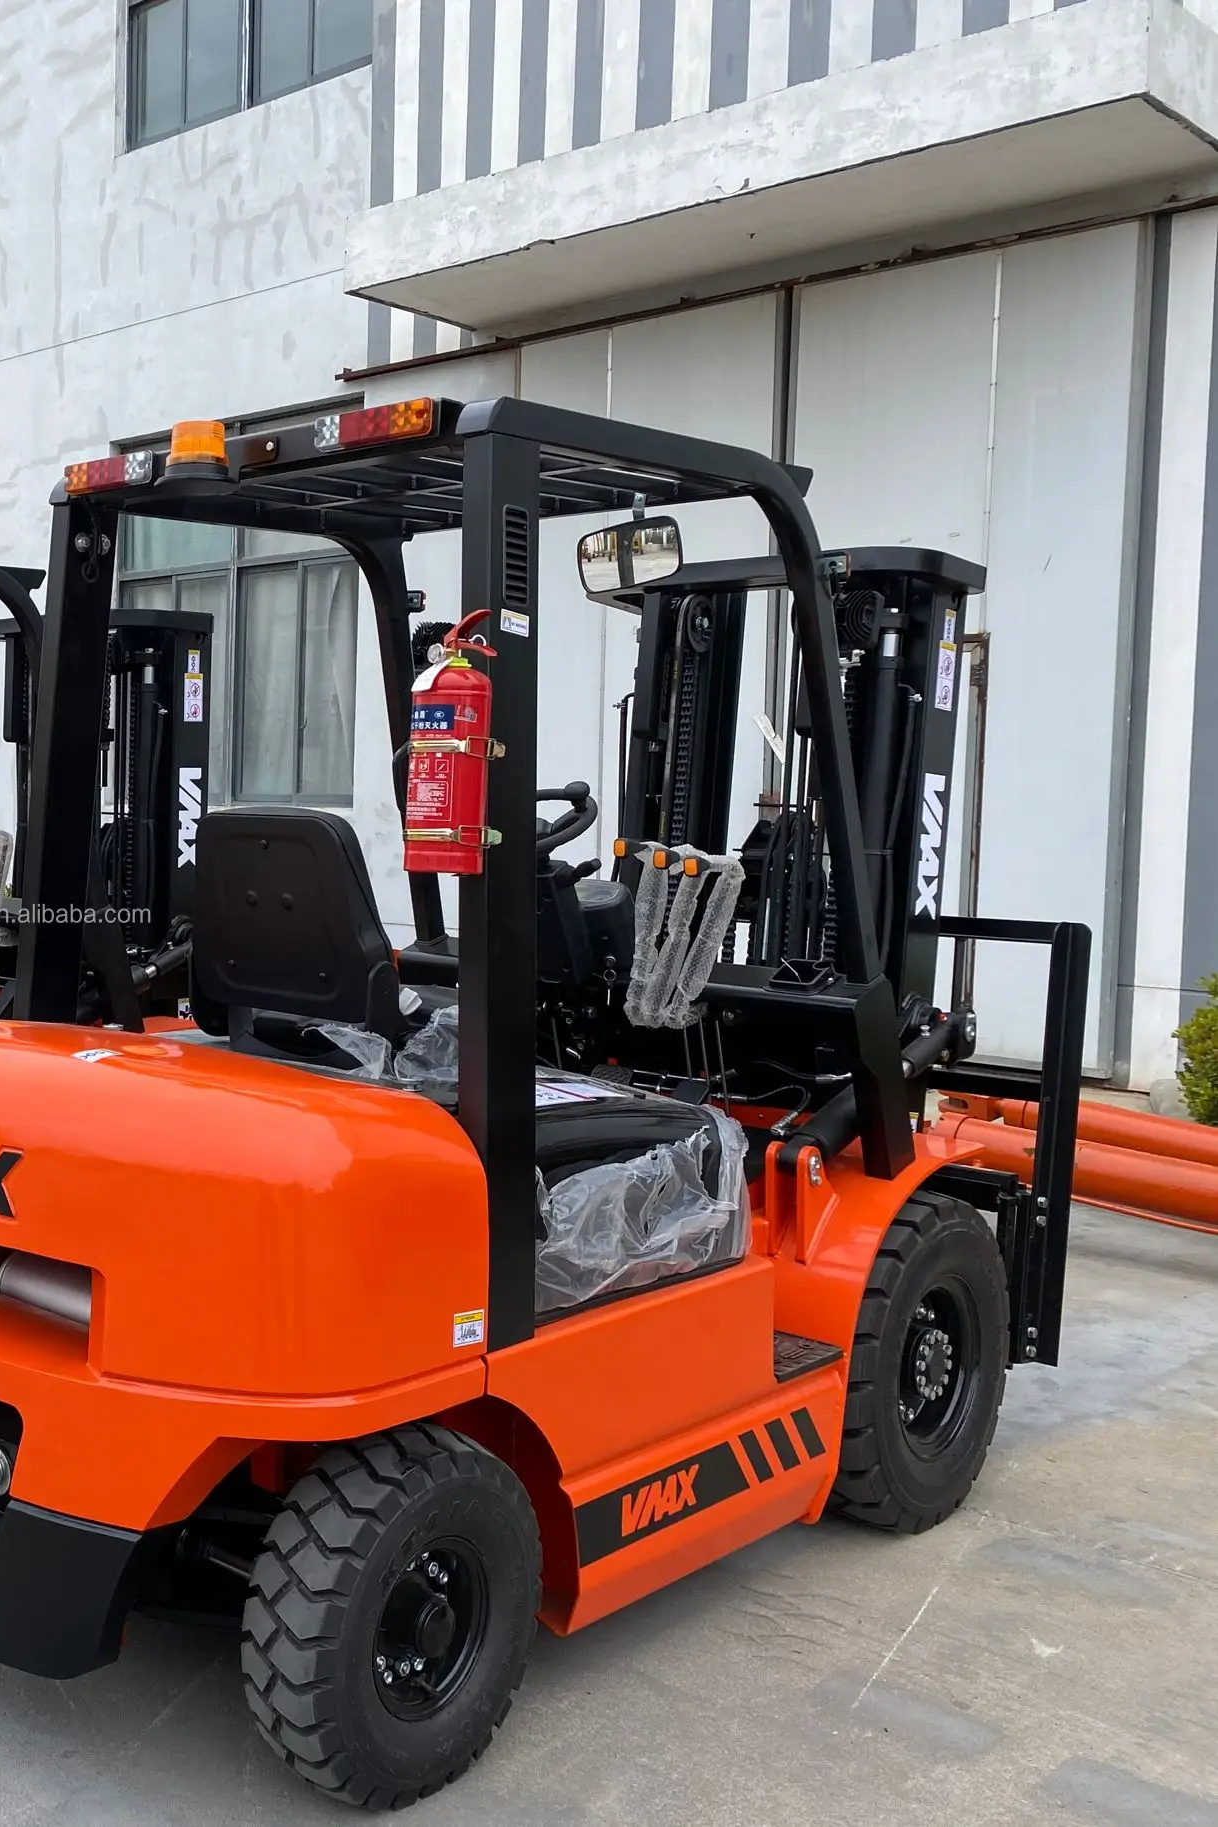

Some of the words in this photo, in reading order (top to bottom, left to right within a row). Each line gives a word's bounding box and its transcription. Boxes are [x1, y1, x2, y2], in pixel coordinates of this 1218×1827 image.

[177, 767, 202, 869] VMAX
[914, 772, 946, 920] VMAX
[621, 1463, 699, 1537] VMAX
